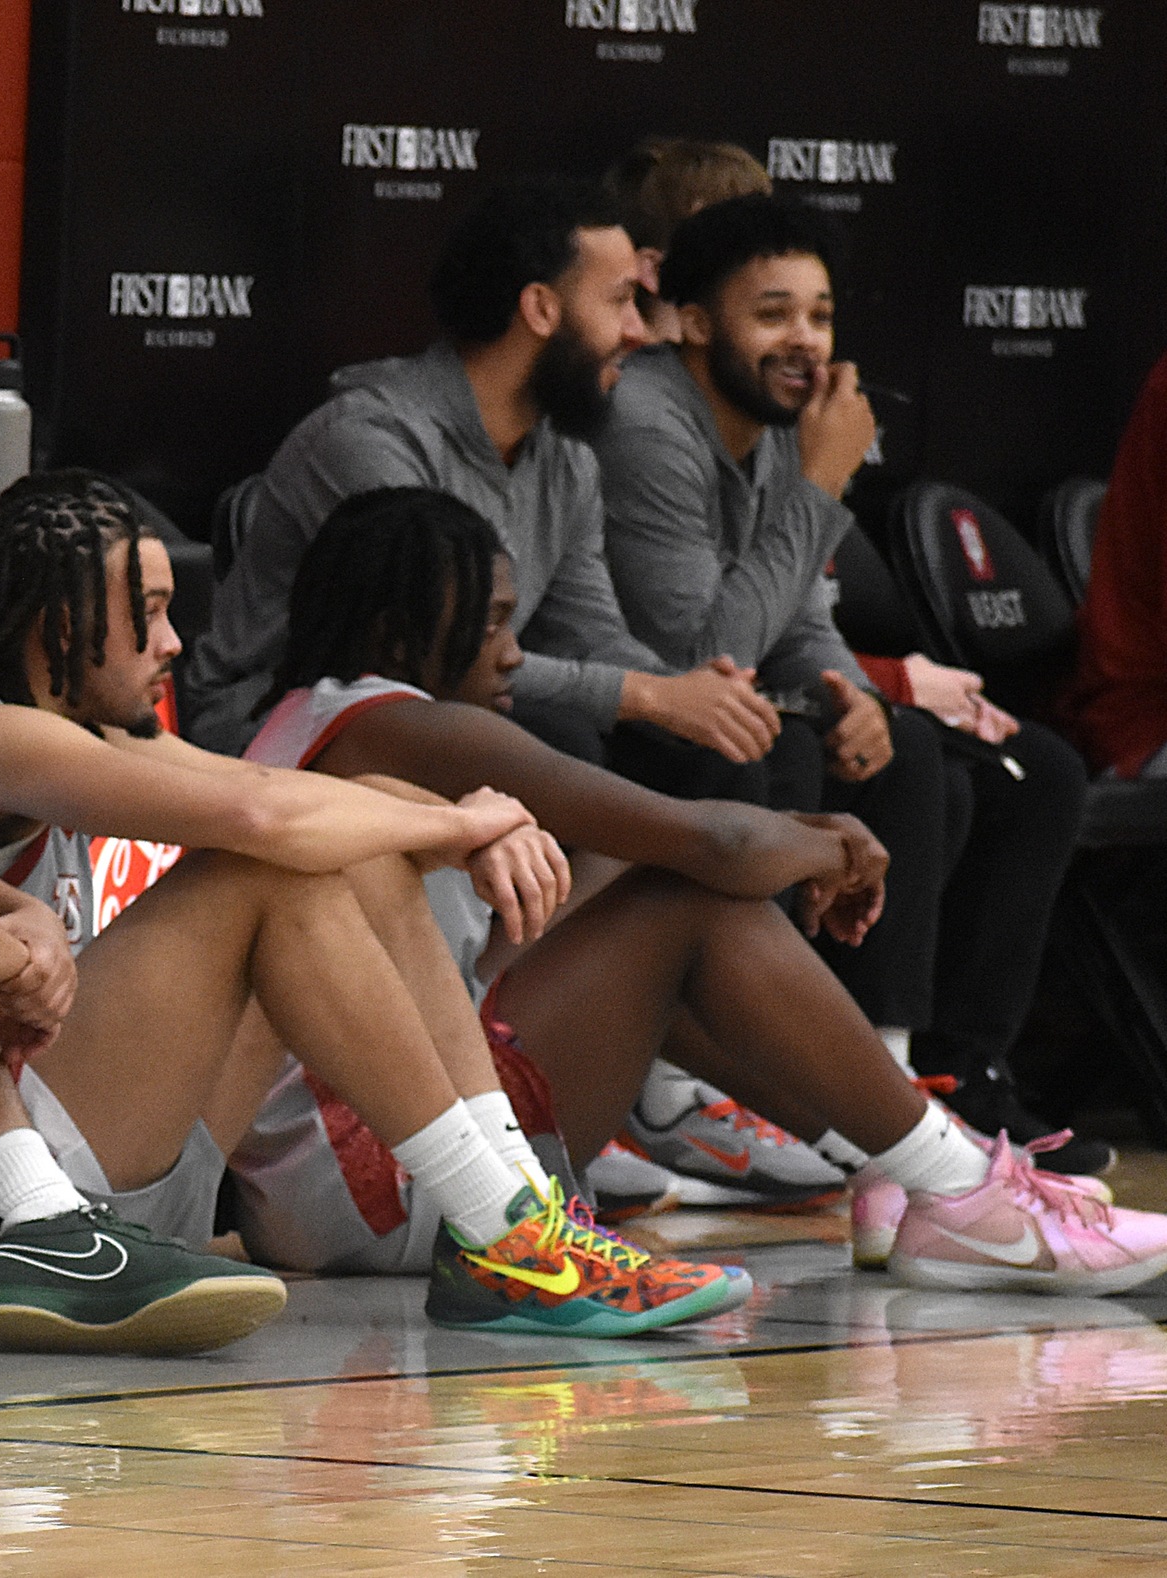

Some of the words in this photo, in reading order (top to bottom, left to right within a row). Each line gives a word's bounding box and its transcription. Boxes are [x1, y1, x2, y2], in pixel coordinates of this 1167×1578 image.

[977, 3, 1029, 44] FIRST
[1045, 7, 1103, 48] BANK
[342, 123, 396, 168] FIRST
[419, 126, 480, 170] BANK
[767, 137, 818, 181] FIRST
[838, 141, 898, 184] BANK
[109, 271, 167, 317] FIRST
[190, 273, 254, 318] BANK
[964, 285, 1013, 328] FIRST
[1030, 287, 1088, 329] BANK
